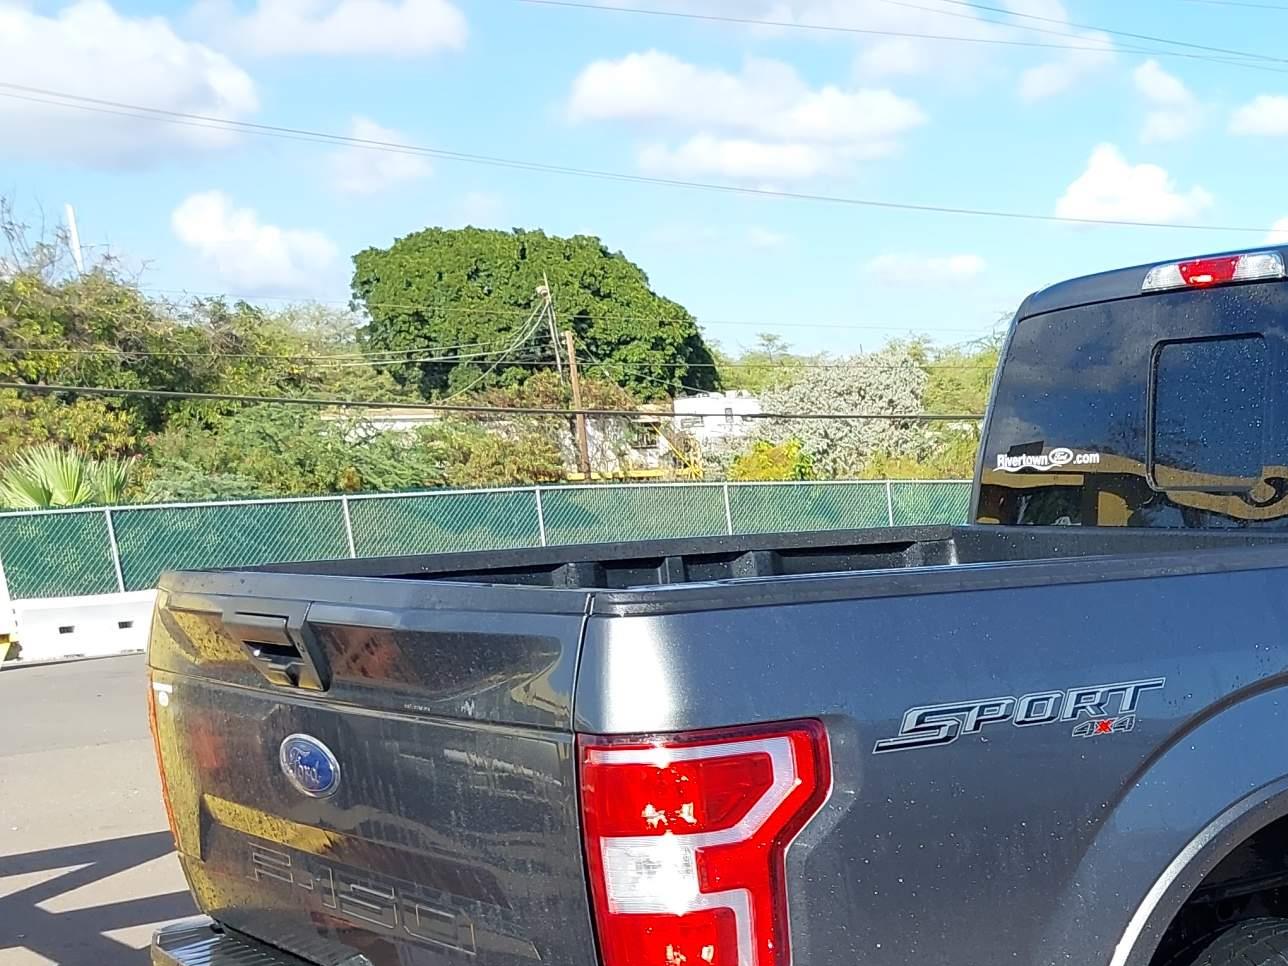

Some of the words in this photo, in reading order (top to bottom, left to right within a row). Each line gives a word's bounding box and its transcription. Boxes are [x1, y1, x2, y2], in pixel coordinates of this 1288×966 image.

[997, 454, 1048, 468] Rivertown
[1073, 453, 1100, 464] .com
[872, 677, 1167, 755] SPORT
[289, 746, 323, 785] Ford
